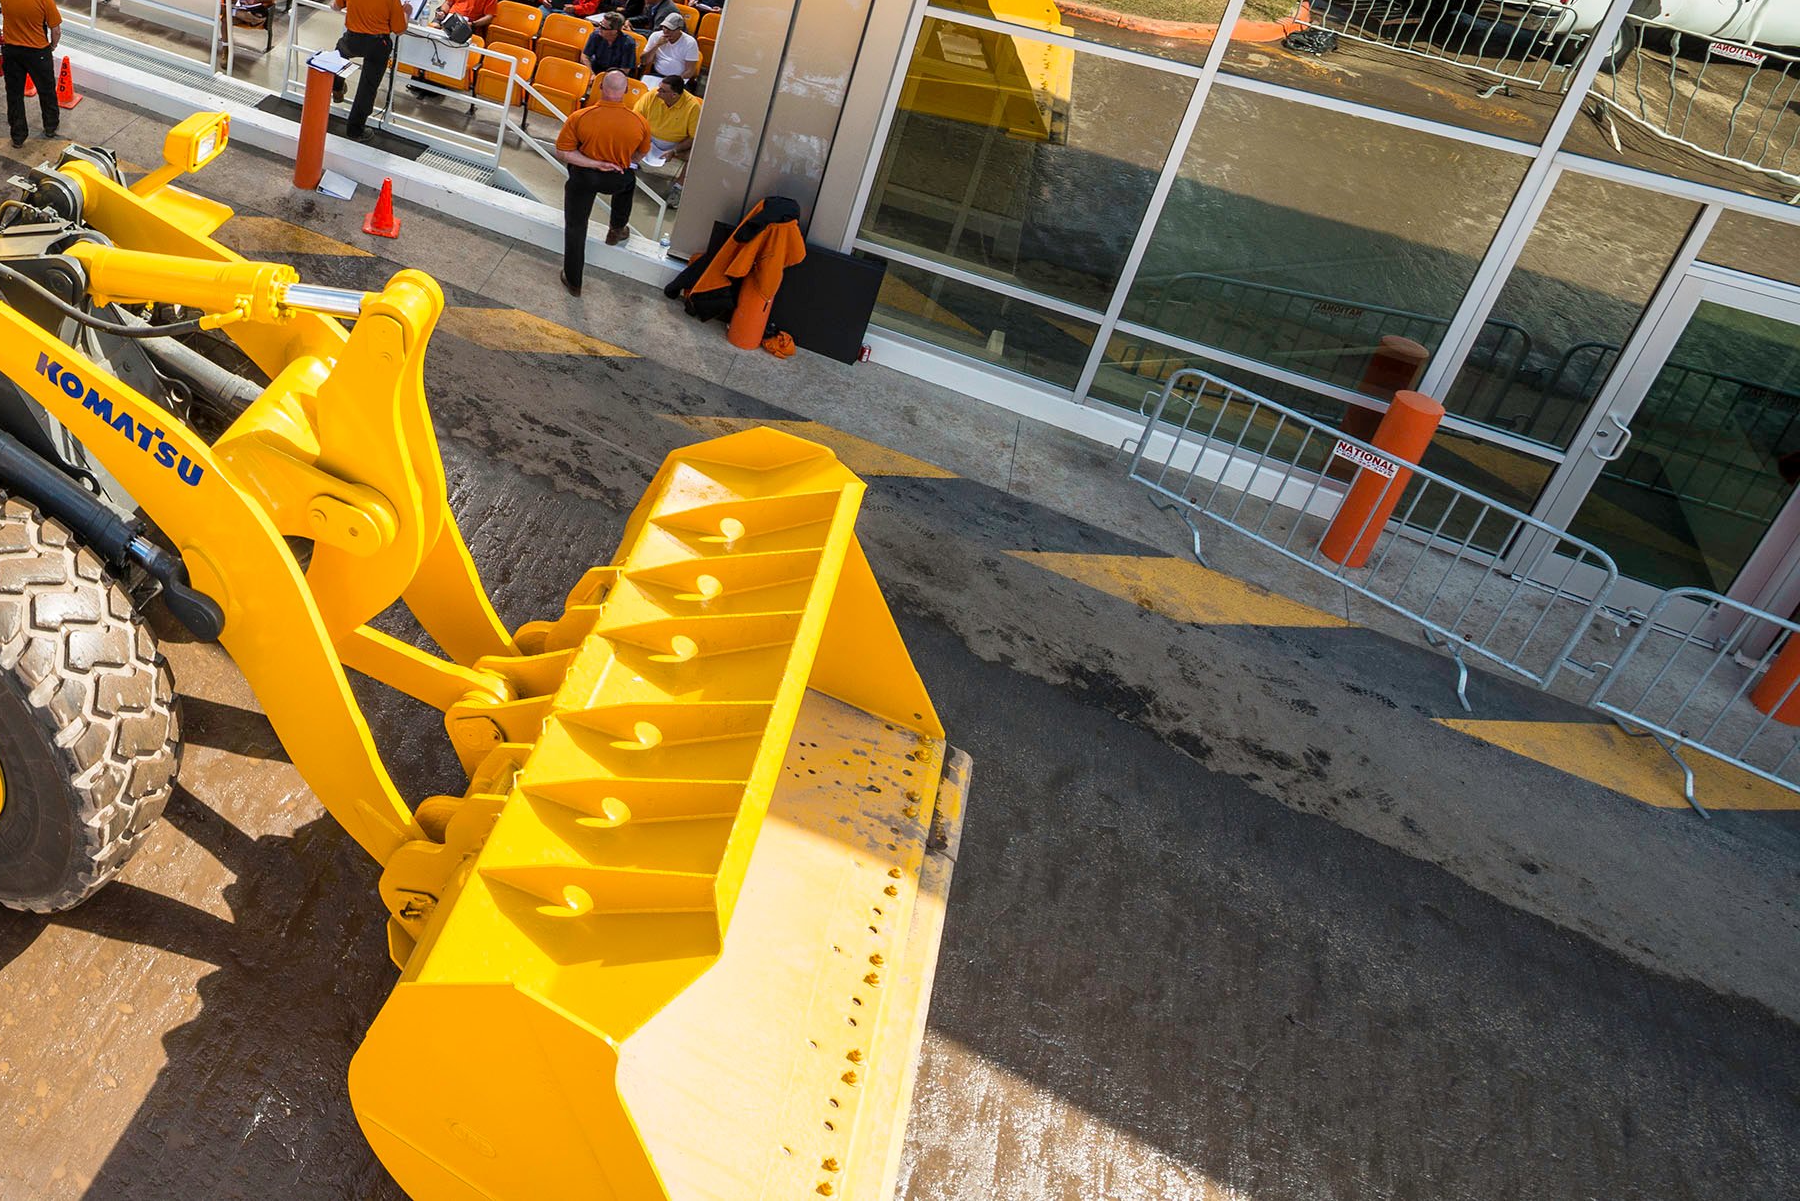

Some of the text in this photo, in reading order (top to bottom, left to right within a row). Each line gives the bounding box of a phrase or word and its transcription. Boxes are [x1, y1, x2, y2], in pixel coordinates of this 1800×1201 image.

[59, 61, 68, 92] SOLD
[34, 351, 205, 488] KOMATSU
[1337, 441, 1395, 473] NATIONAL
